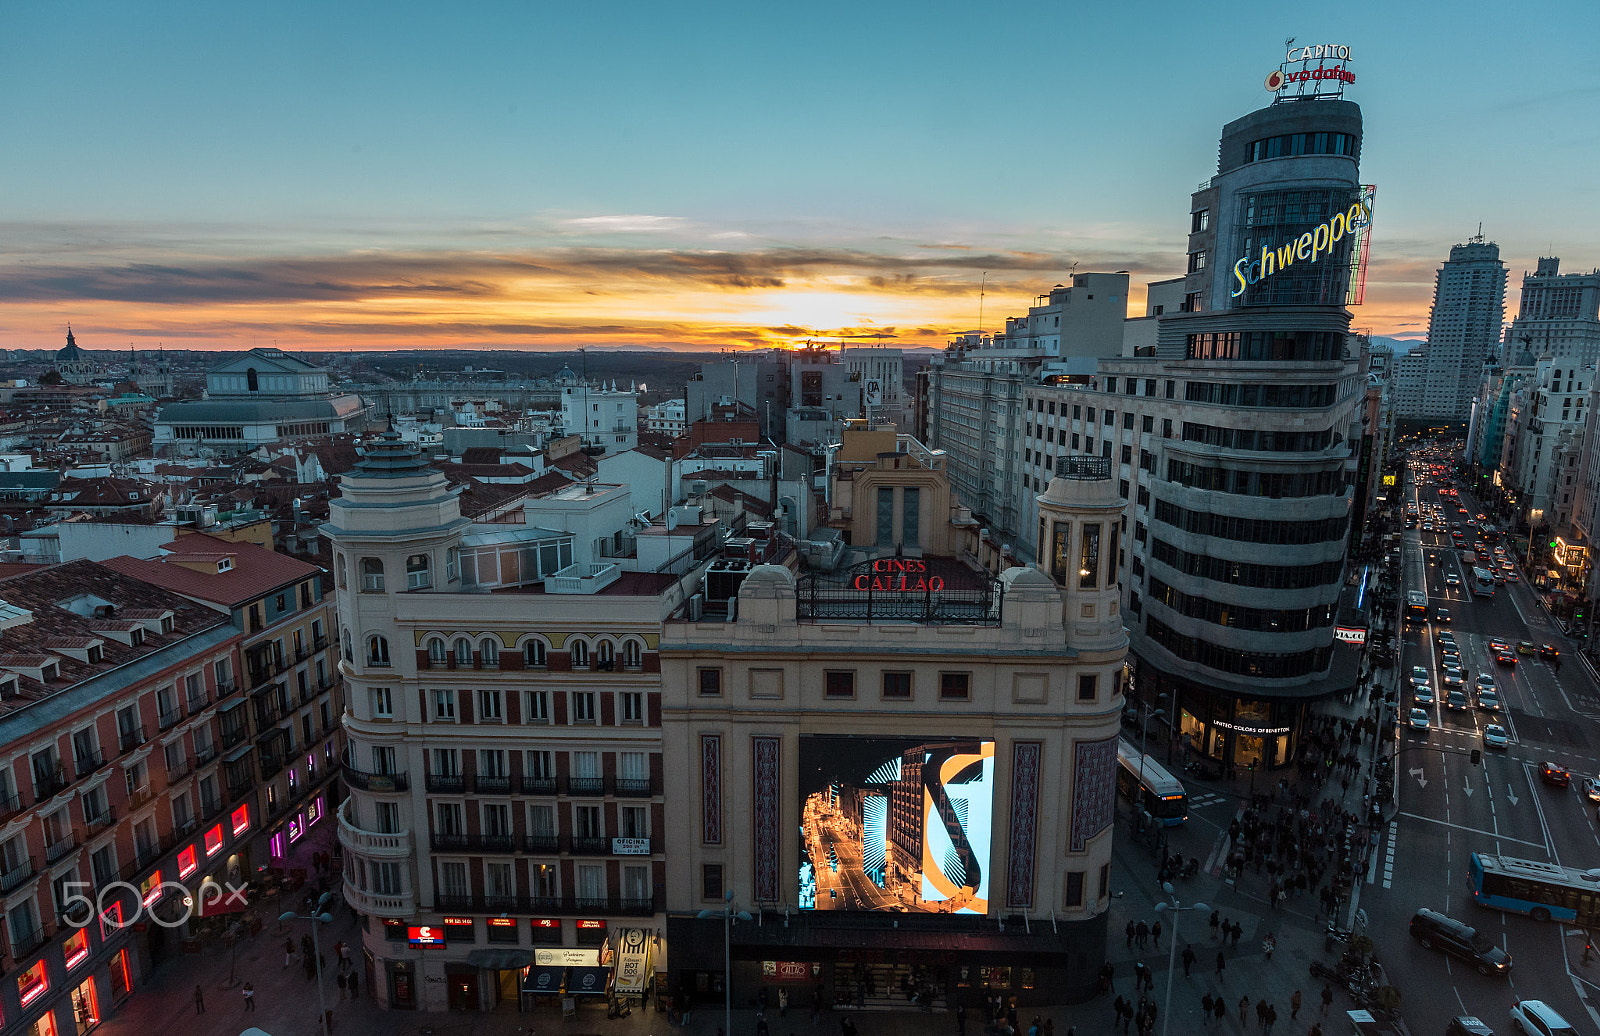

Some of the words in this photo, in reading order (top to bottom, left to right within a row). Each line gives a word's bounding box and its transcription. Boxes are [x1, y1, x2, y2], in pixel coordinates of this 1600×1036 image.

[1287, 44, 1353, 62] CAPITOL
[1288, 65, 1356, 84] vodafone
[1231, 193, 1373, 298] Schweppes
[1360, 437, 1372, 483] HOTEL
[874, 559, 926, 573] CINES
[854, 575, 945, 592] CALLAO
[1213, 719, 1233, 729] UNITED
[1233, 725, 1256, 733] COLORS
